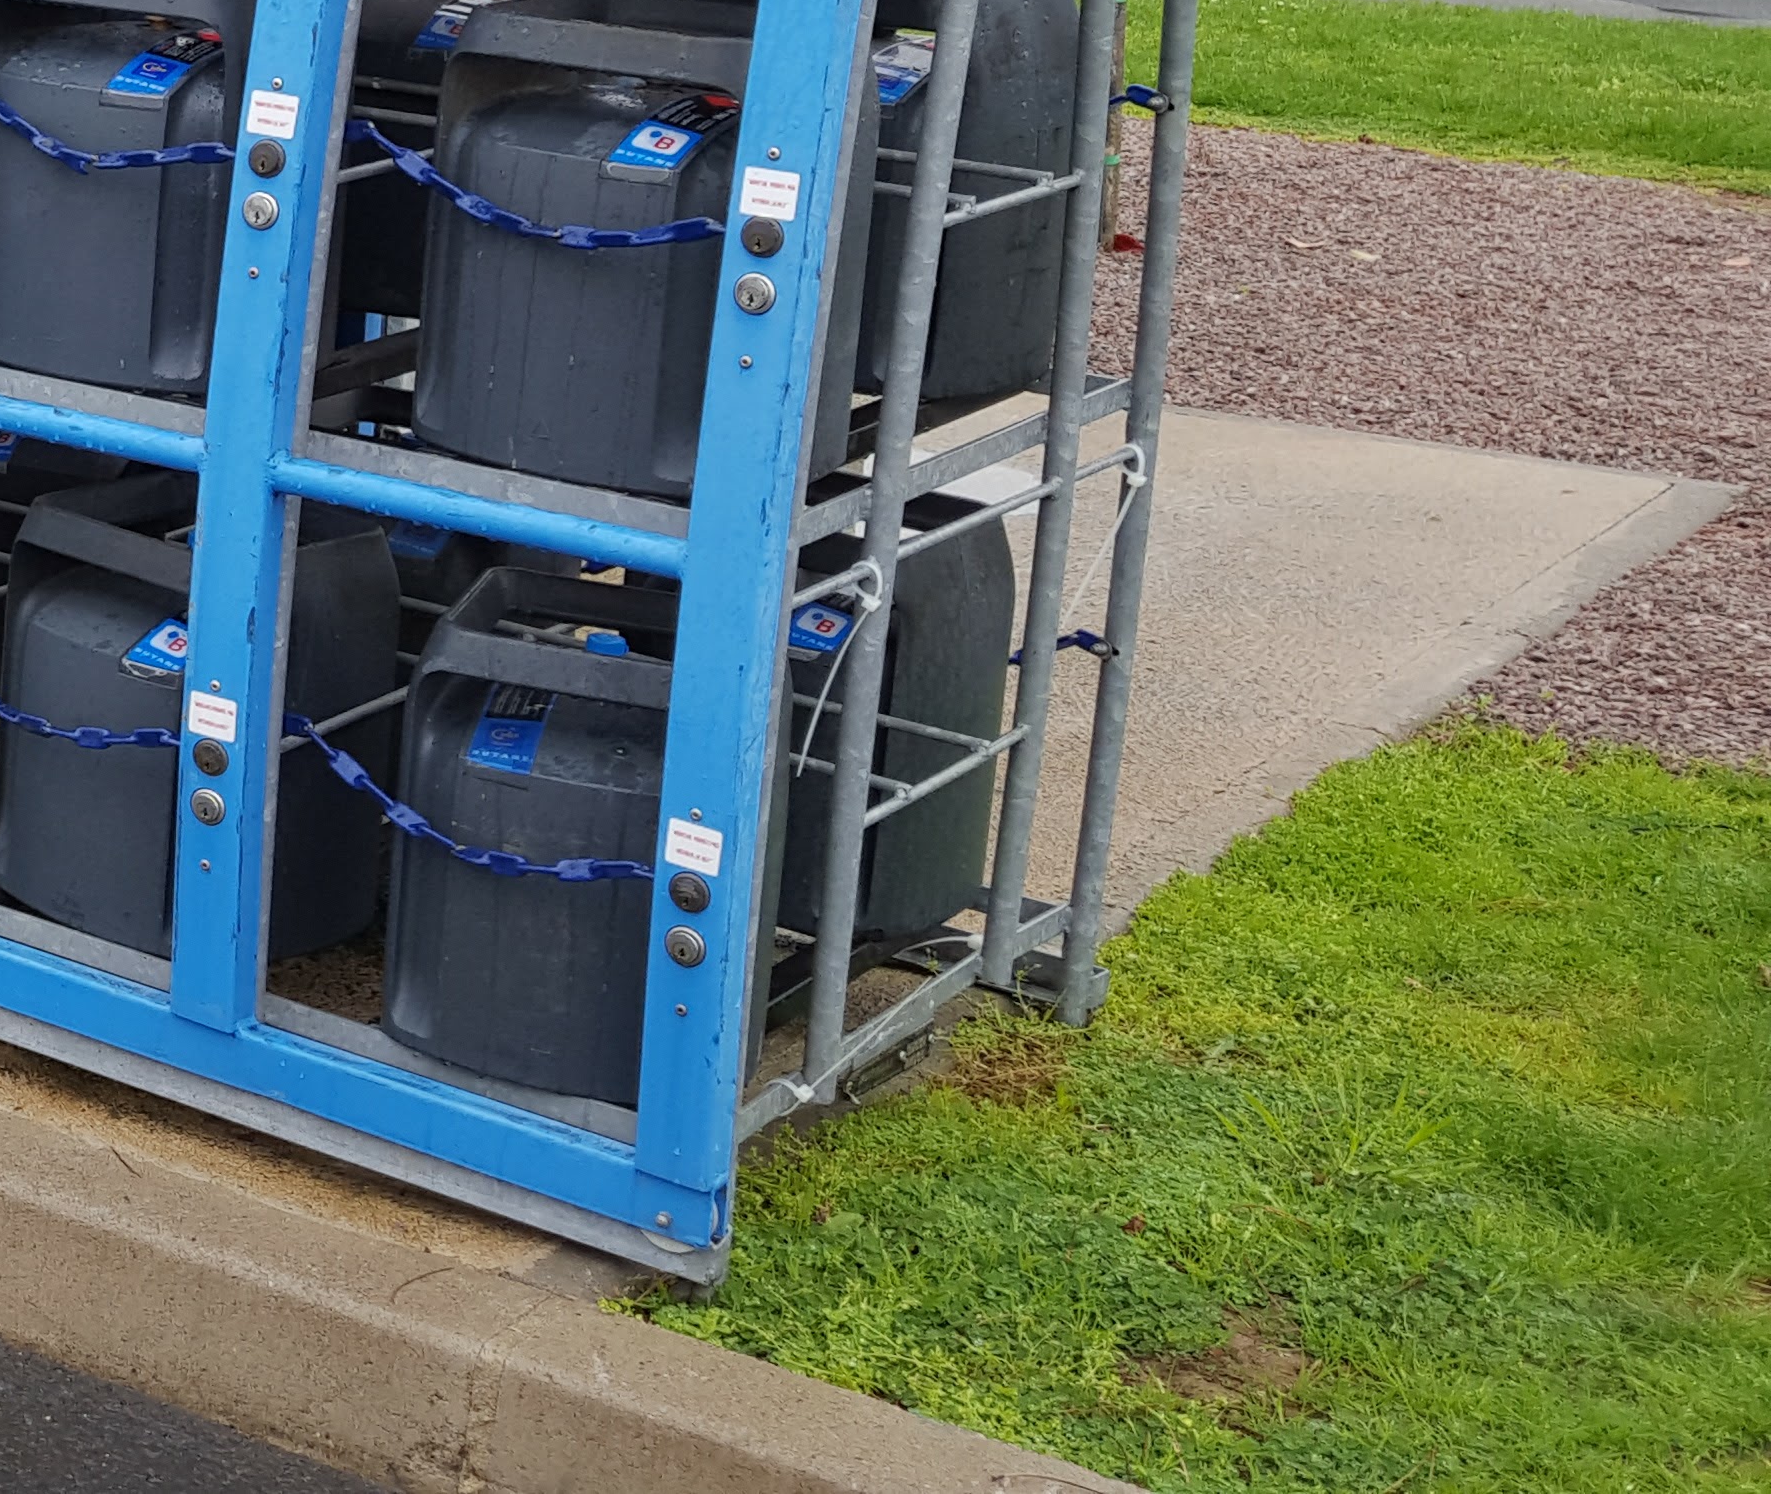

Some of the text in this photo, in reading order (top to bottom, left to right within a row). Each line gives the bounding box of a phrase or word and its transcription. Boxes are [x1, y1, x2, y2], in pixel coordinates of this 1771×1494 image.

[653, 136, 676, 150] B
[815, 618, 836, 634] B
[167, 637, 188, 652] B
